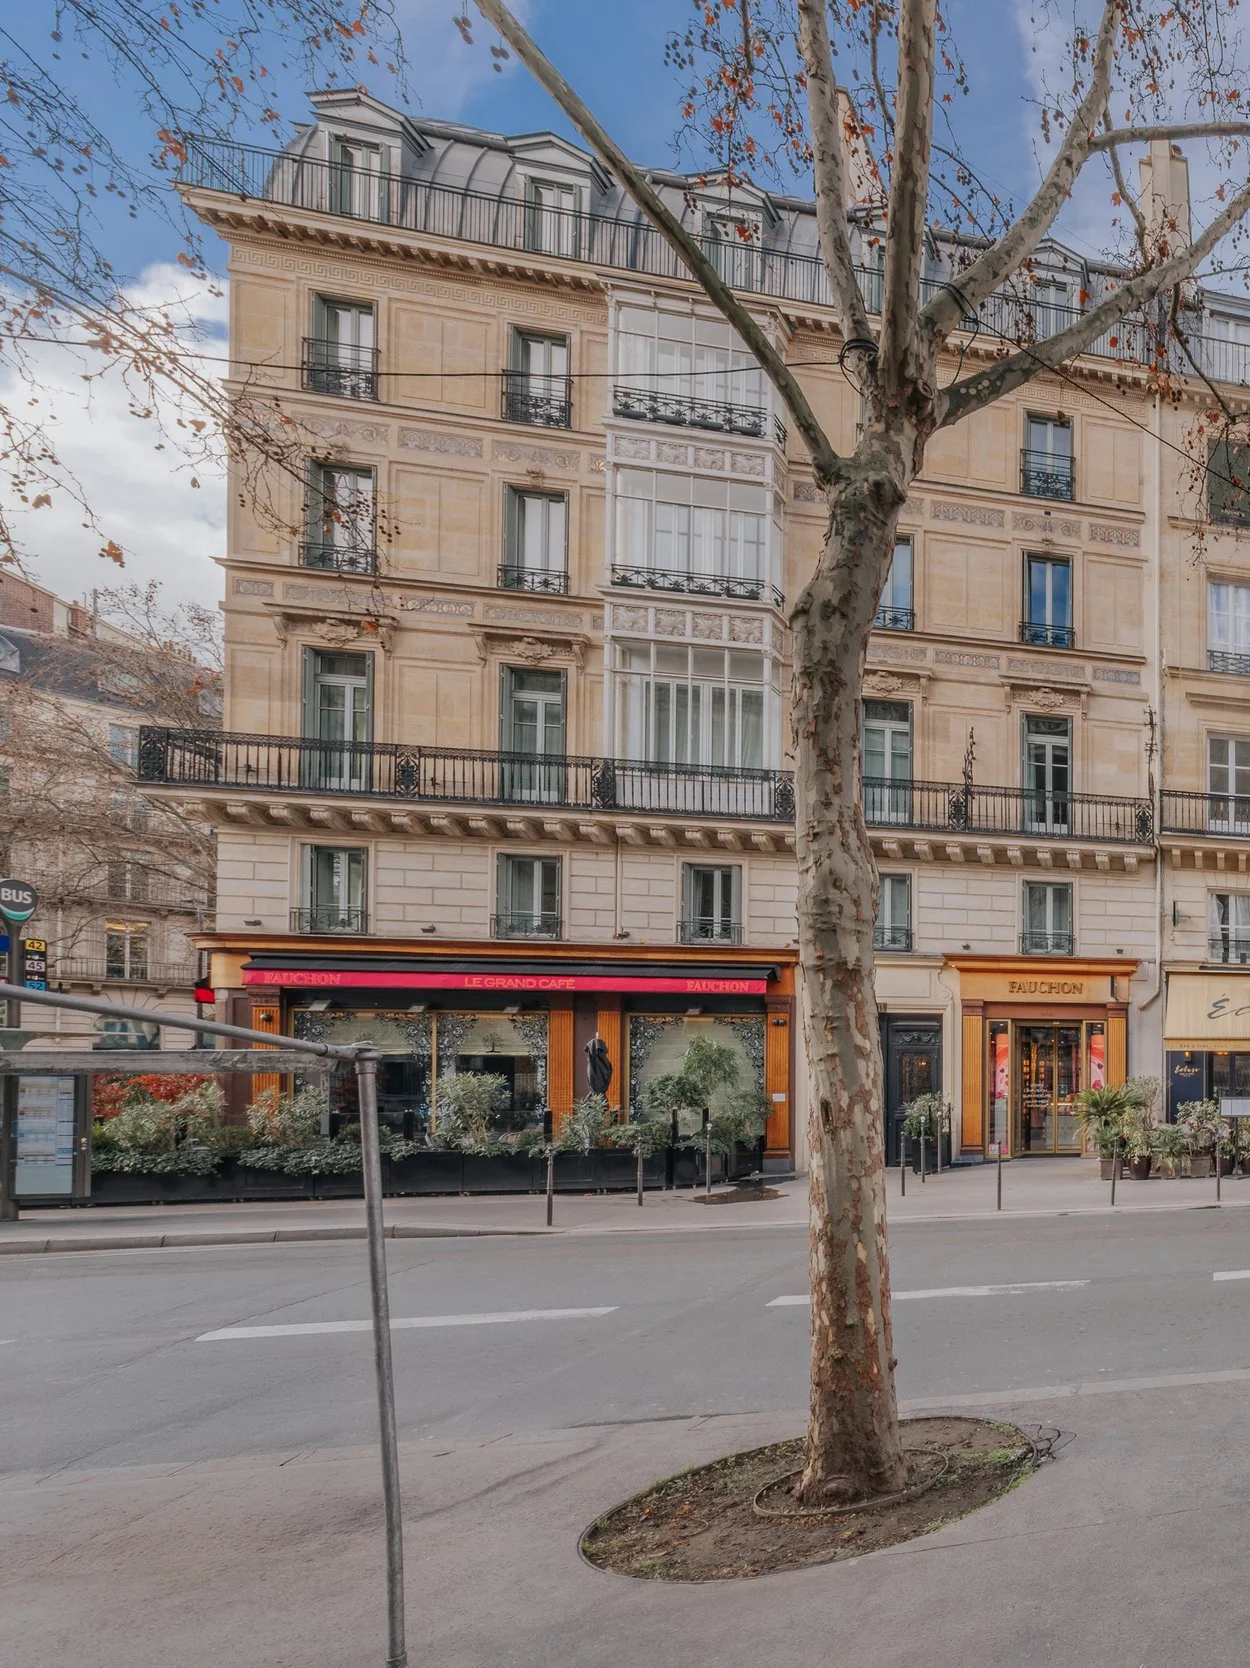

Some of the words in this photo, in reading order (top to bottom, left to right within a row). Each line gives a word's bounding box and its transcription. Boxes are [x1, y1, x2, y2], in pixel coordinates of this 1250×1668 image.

[1, 888, 32, 904] BUS
[28, 942, 42, 950] 42
[28, 962, 43, 970] 45
[264, 972, 341, 984] FAUCHON
[464, 977, 481, 988] LE
[484, 978, 536, 989] GRAND
[539, 978, 576, 989] CAFÉ
[28, 982, 42, 990] 52
[686, 980, 749, 992] FAUCHON
[1008, 981, 1084, 994] FAUCHON
